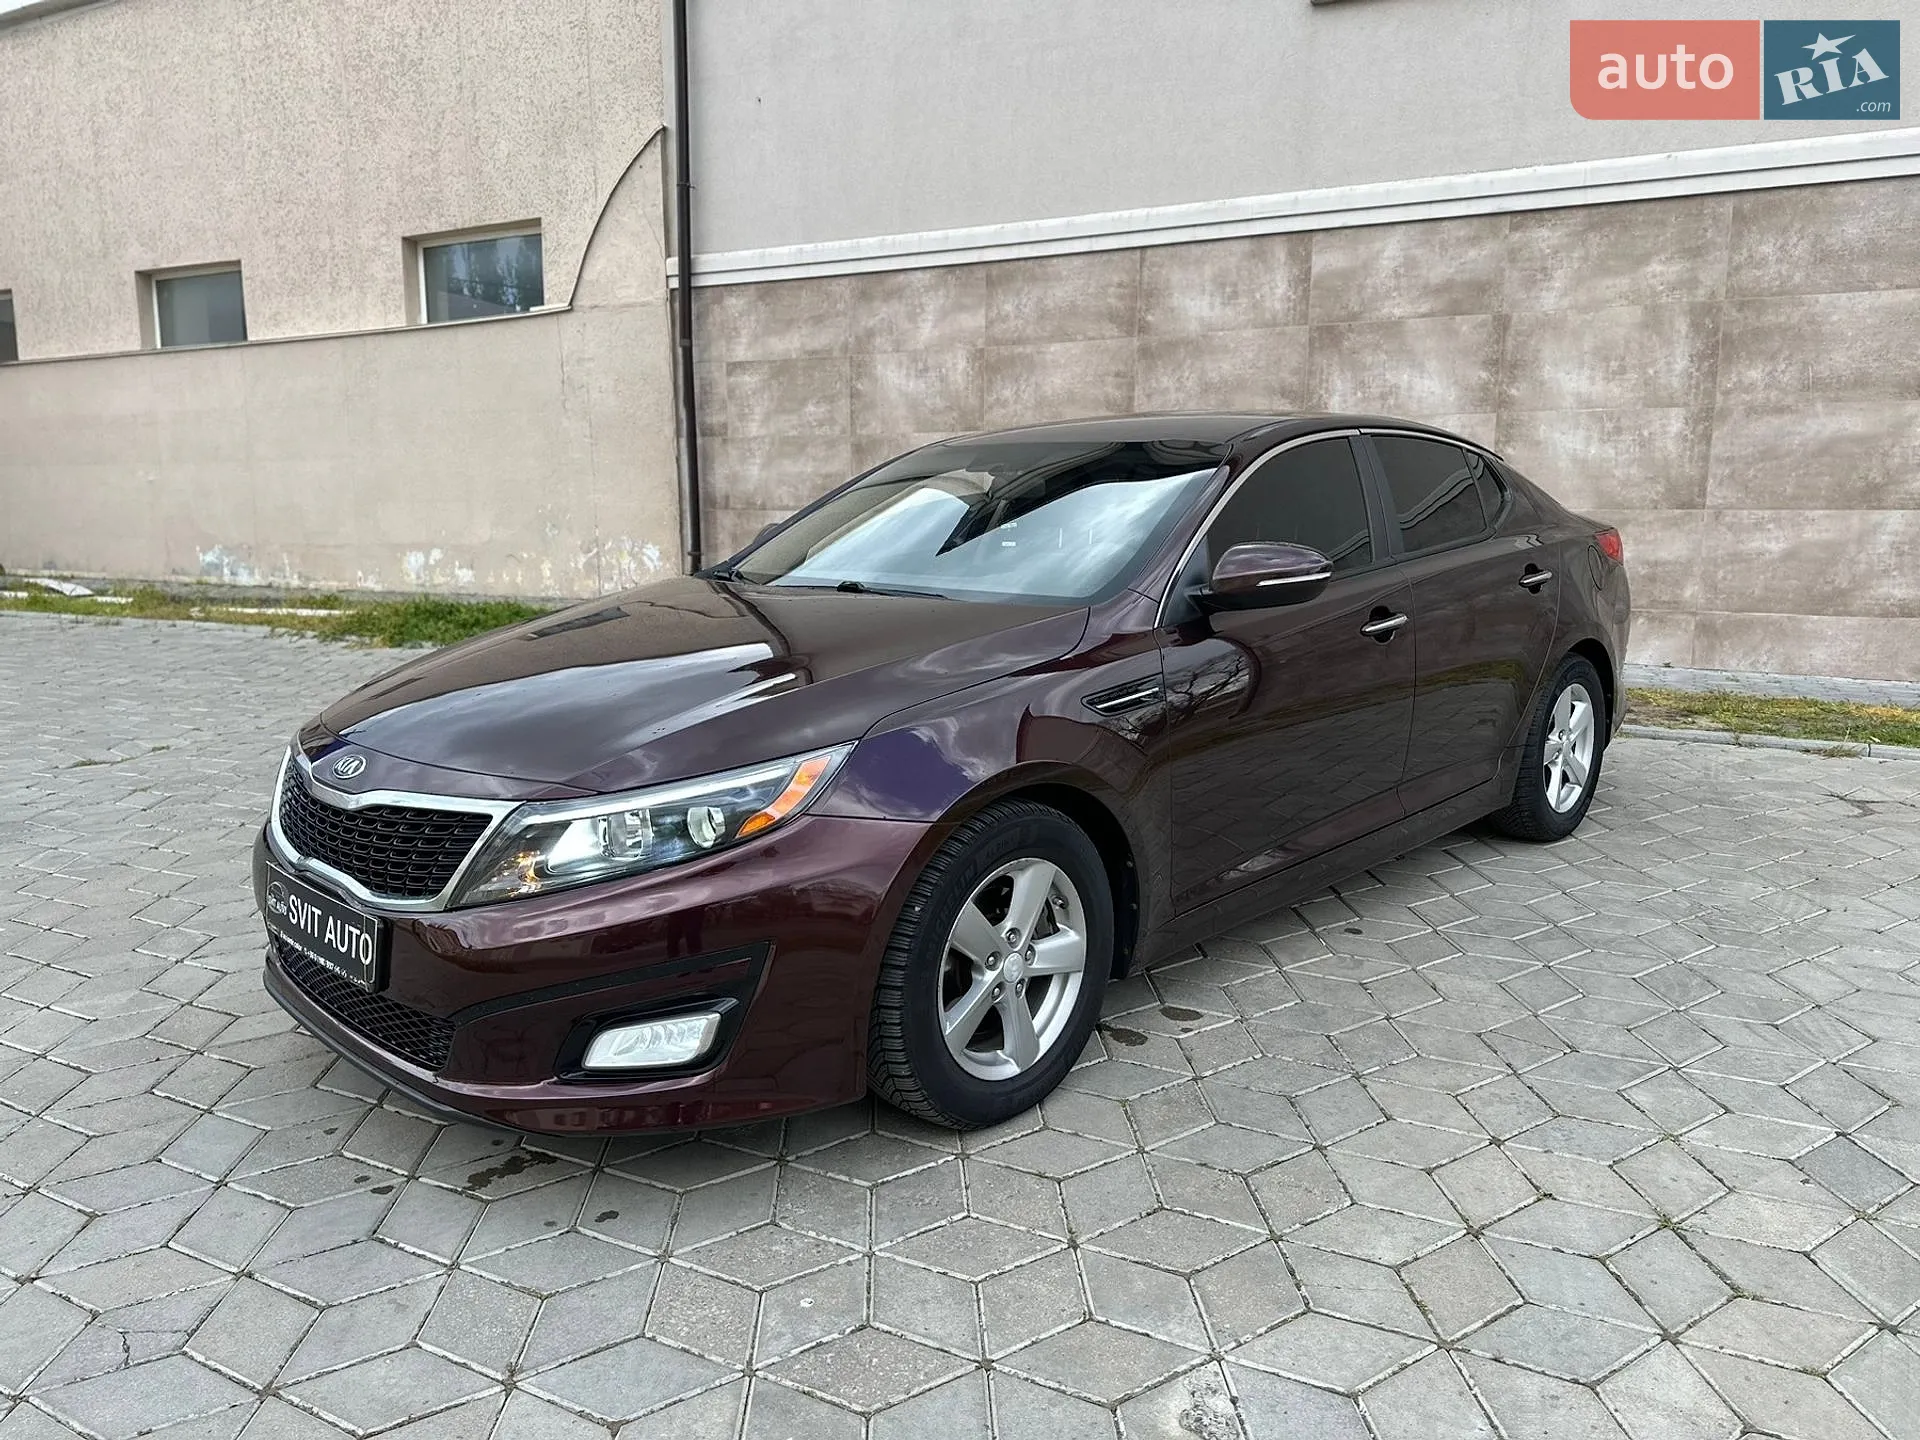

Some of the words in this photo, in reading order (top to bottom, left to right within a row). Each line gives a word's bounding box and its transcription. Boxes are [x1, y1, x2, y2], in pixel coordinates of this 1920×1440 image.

[335, 757, 360, 775] KIA
[289, 894, 322, 938] SVIT
[324, 916, 373, 965] AUTO
